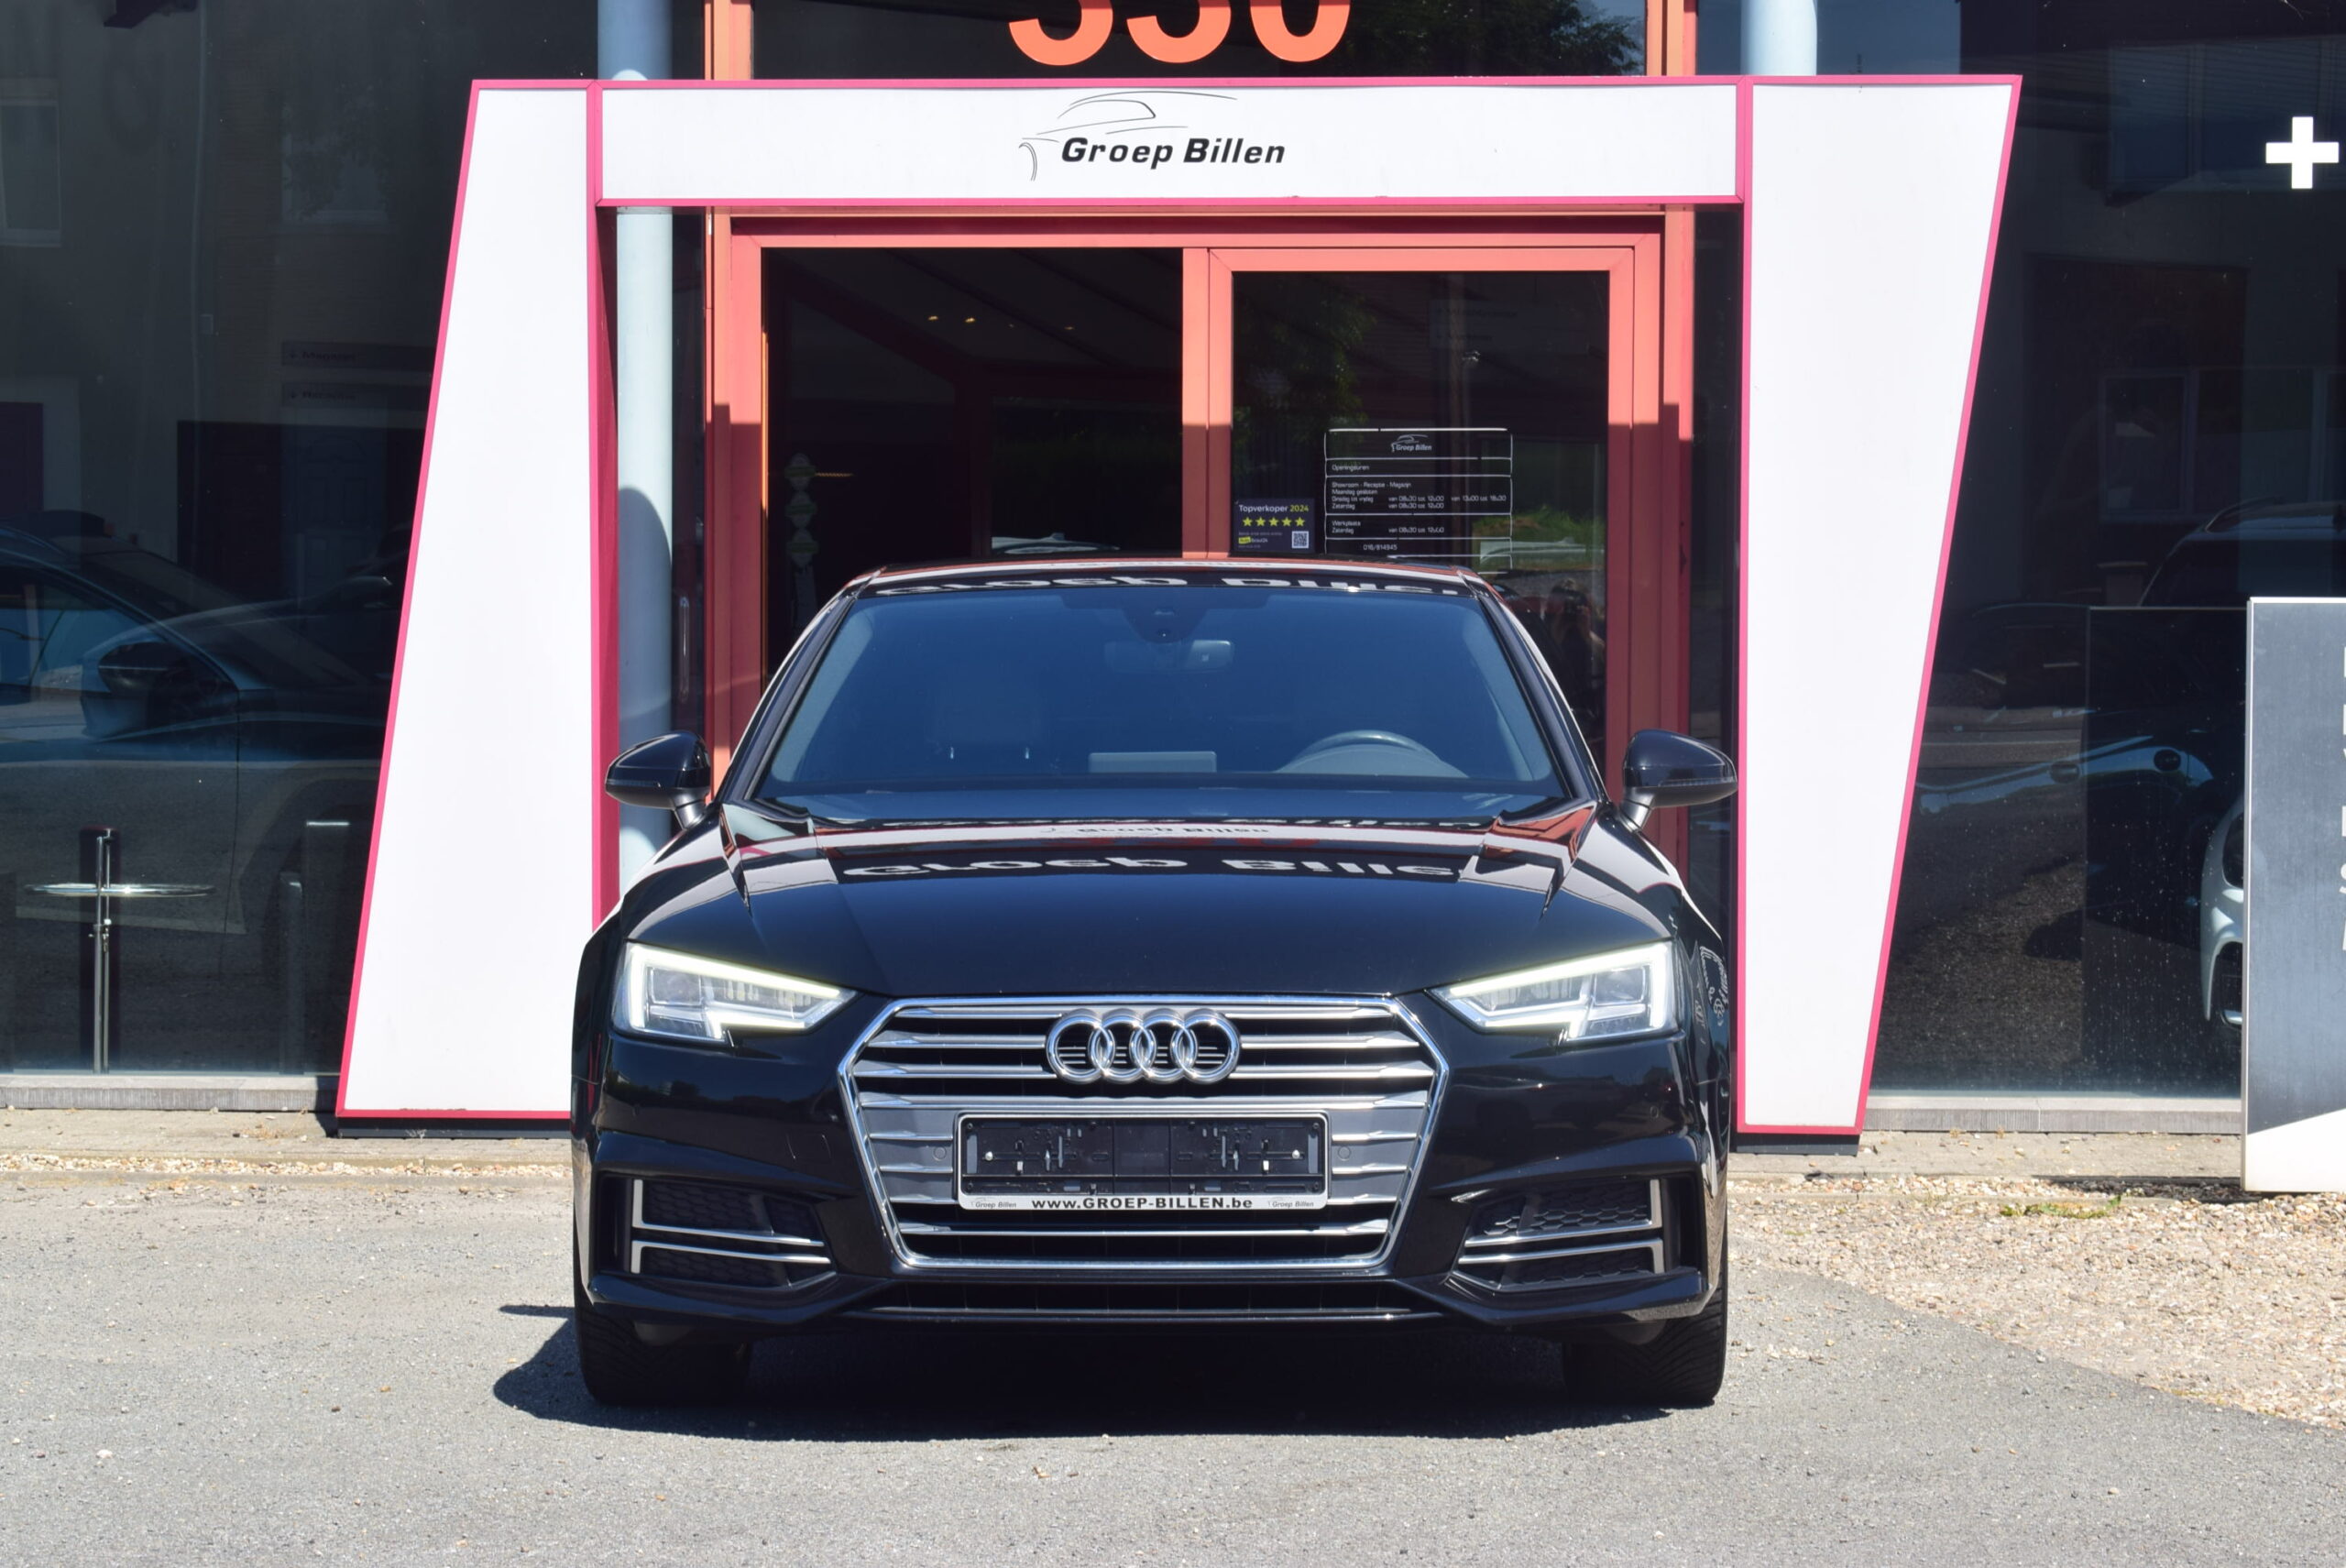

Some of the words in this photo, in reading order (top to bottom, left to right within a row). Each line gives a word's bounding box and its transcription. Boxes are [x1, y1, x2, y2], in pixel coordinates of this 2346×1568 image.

[1061, 137, 1173, 170] Groep
[1183, 137, 1285, 164] Billen
[1238, 504, 1288, 513] Topverkoper
[1289, 504, 1310, 512] 2024
[1032, 1197, 1253, 1209] www.GROEP-BILLEN.be
[1272, 1201, 1293, 1209] Groep
